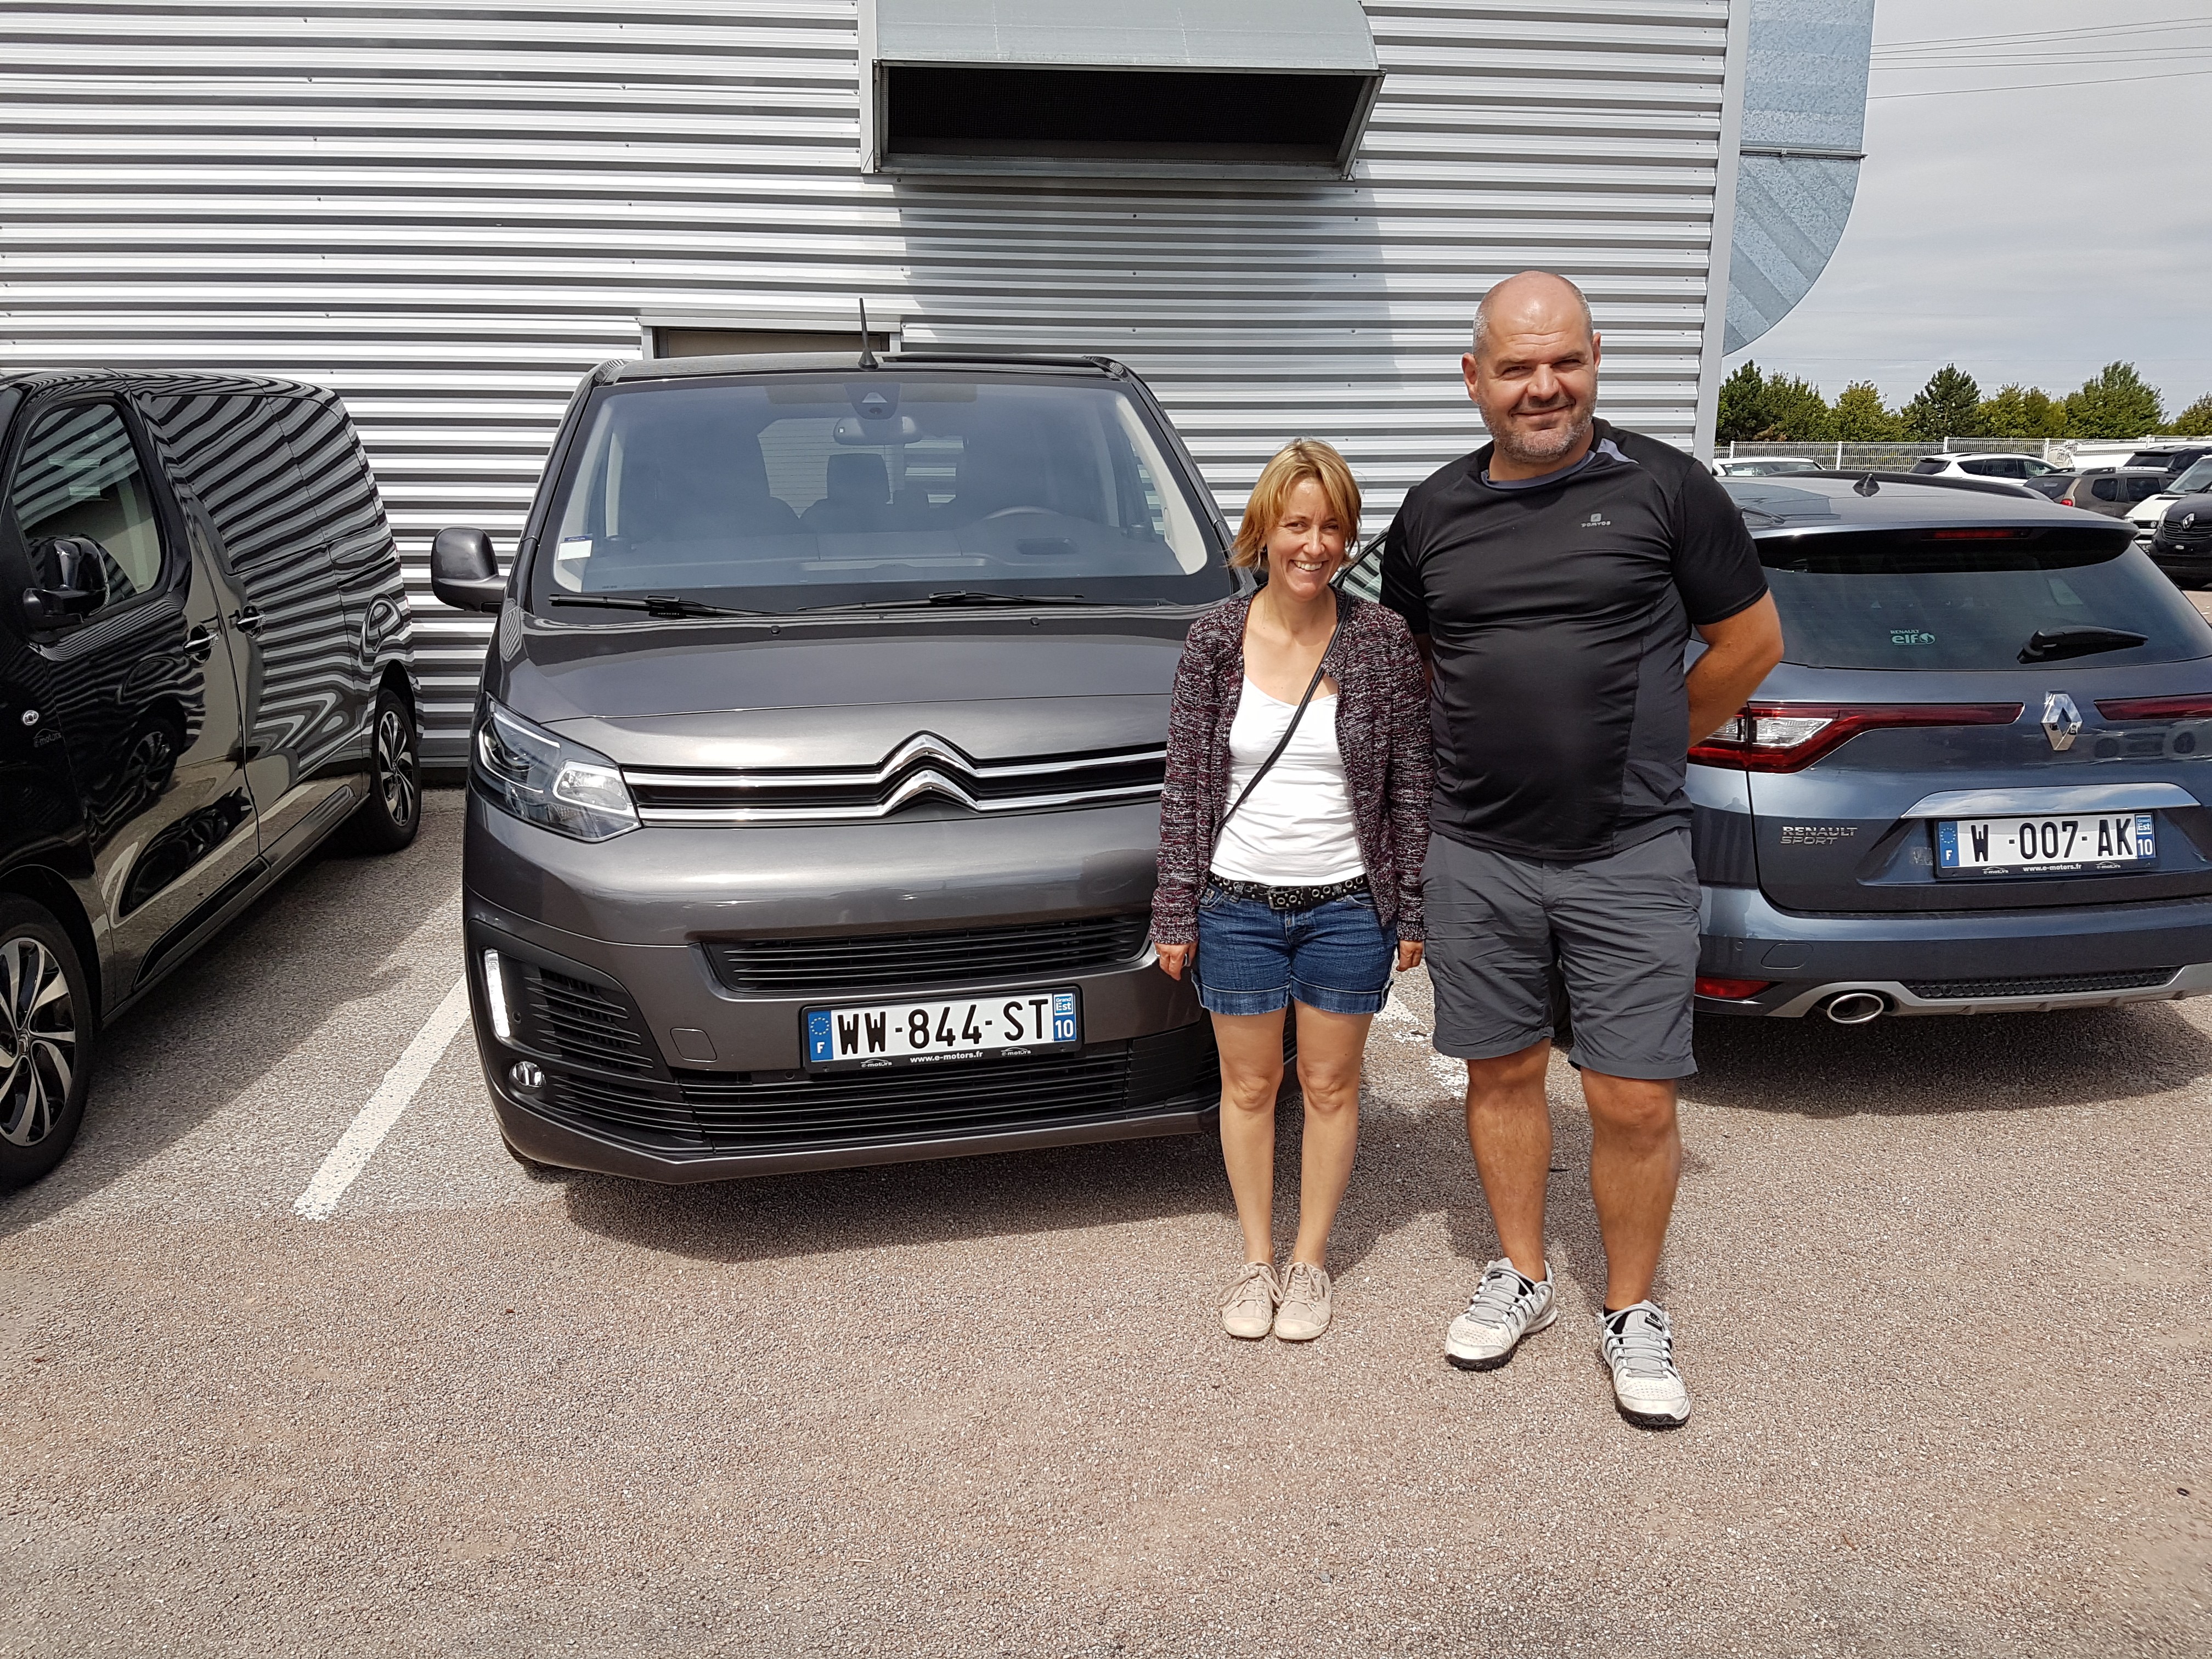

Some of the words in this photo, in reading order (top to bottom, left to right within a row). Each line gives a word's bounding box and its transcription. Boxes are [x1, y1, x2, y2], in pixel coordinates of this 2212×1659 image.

[1892, 634, 1918, 644] elf
[1782, 826, 1858, 836] RENAULT
[1780, 836, 1838, 845] SPORT
[2137, 838, 2153, 856] 10
[1946, 850, 1953, 861] F
[1056, 1002, 1071, 1011] Est
[1055, 1019, 1074, 1039] 10
[816, 1041, 825, 1054] F
[910, 1051, 984, 1063] www.e-motors.fr
